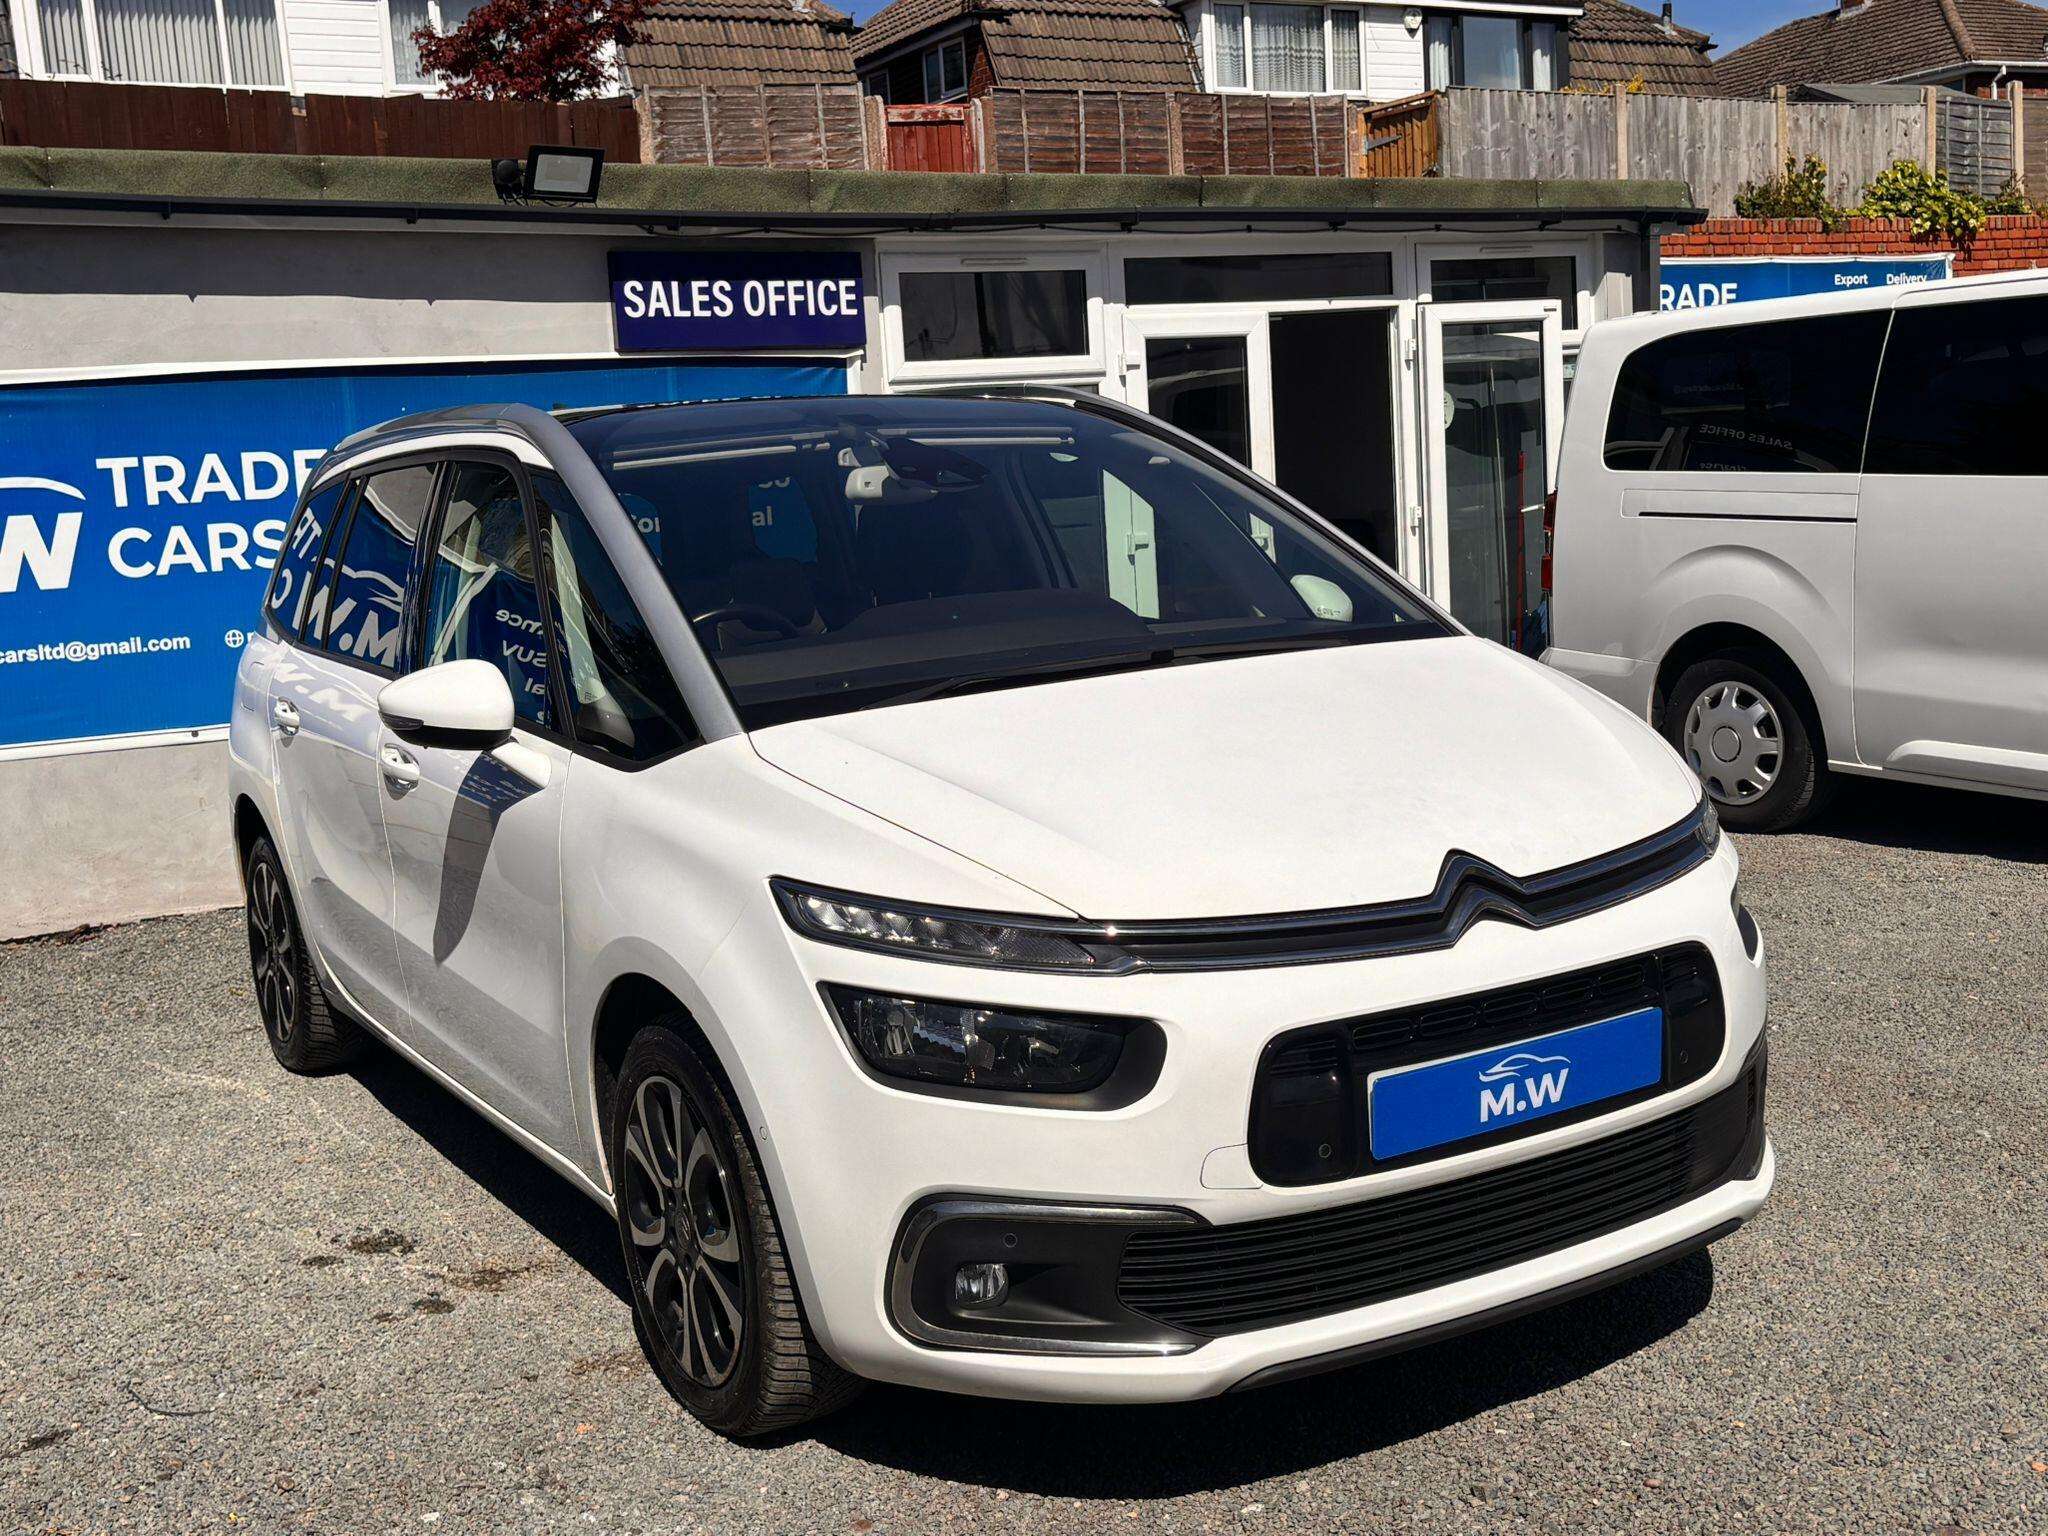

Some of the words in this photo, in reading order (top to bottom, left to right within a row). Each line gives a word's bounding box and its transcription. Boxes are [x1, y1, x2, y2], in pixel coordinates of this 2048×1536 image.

[1834, 273, 1868, 288] Export
[1885, 272, 1928, 285] Delivery
[623, 280, 734, 318] SALES
[743, 279, 858, 317] OFFICE
[1659, 282, 1738, 312] RADE
[108, 520, 287, 578] CARS
[1480, 1068, 1569, 1123] M.W
